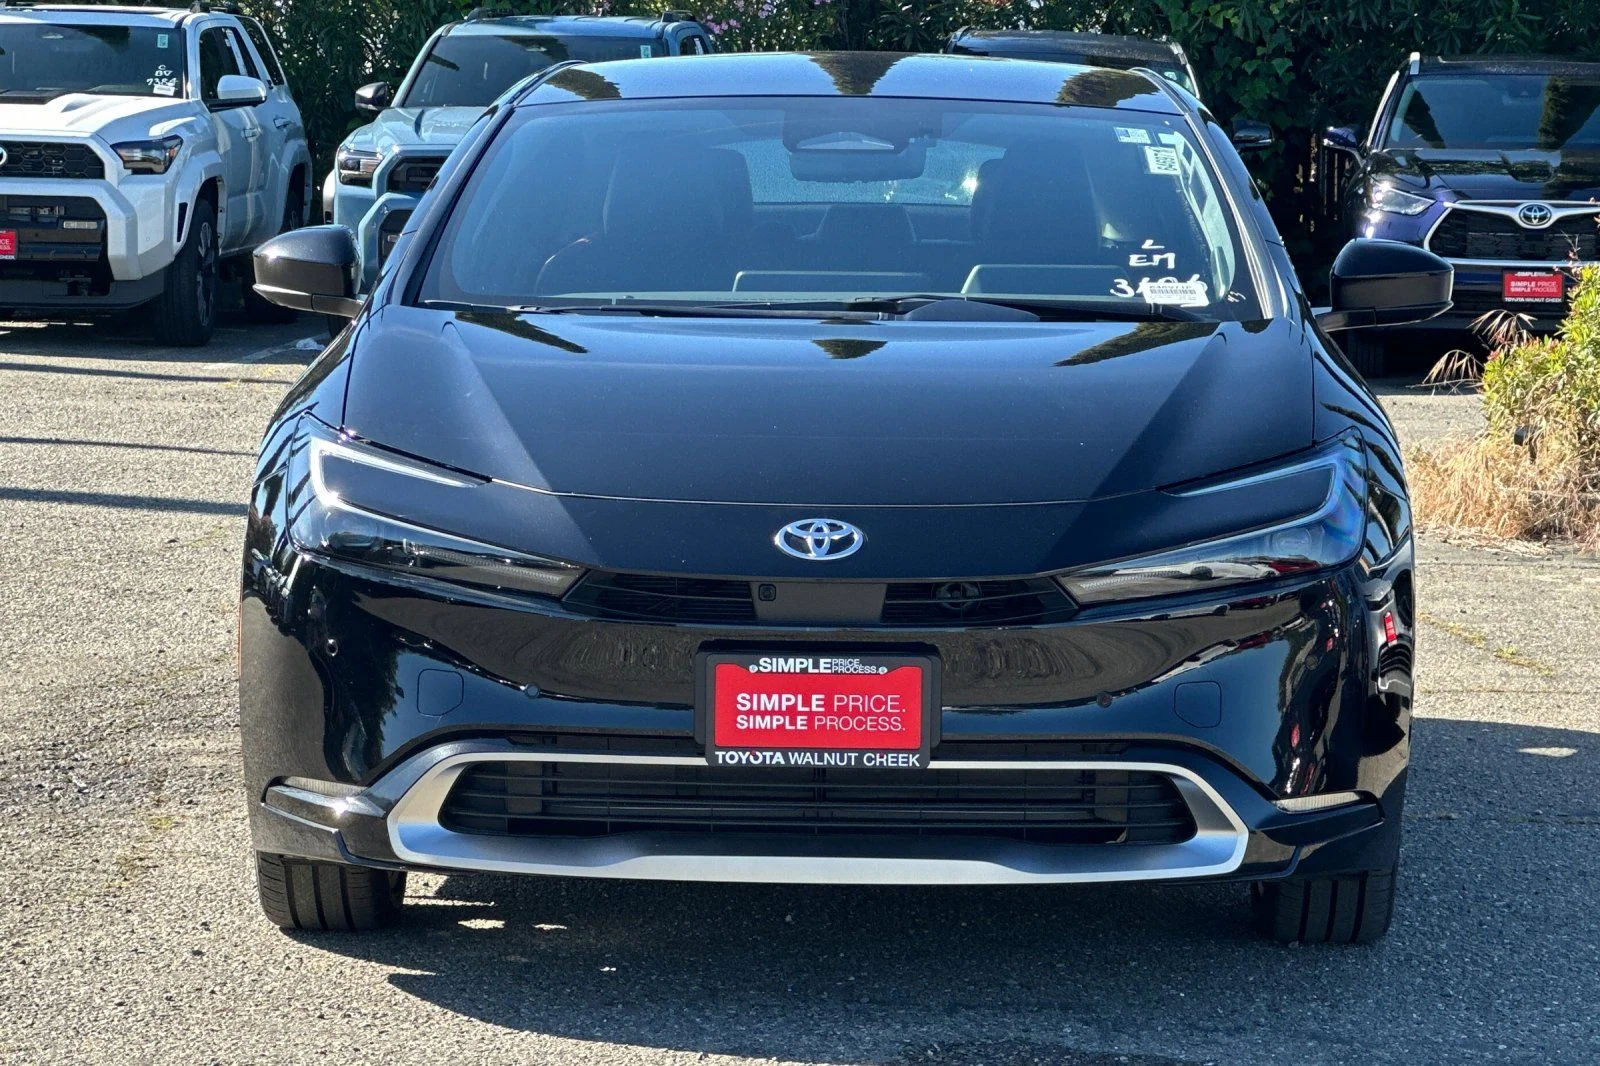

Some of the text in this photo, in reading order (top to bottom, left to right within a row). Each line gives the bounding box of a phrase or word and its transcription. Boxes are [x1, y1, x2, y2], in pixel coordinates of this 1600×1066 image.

[759, 658, 831, 673] SIMPLE
[736, 693, 906, 713] SIMPLE PRICE.
[736, 715, 906, 731] SIMPLE PROCESS.
[715, 751, 920, 767] TOYOTA WALNUT CREEK
